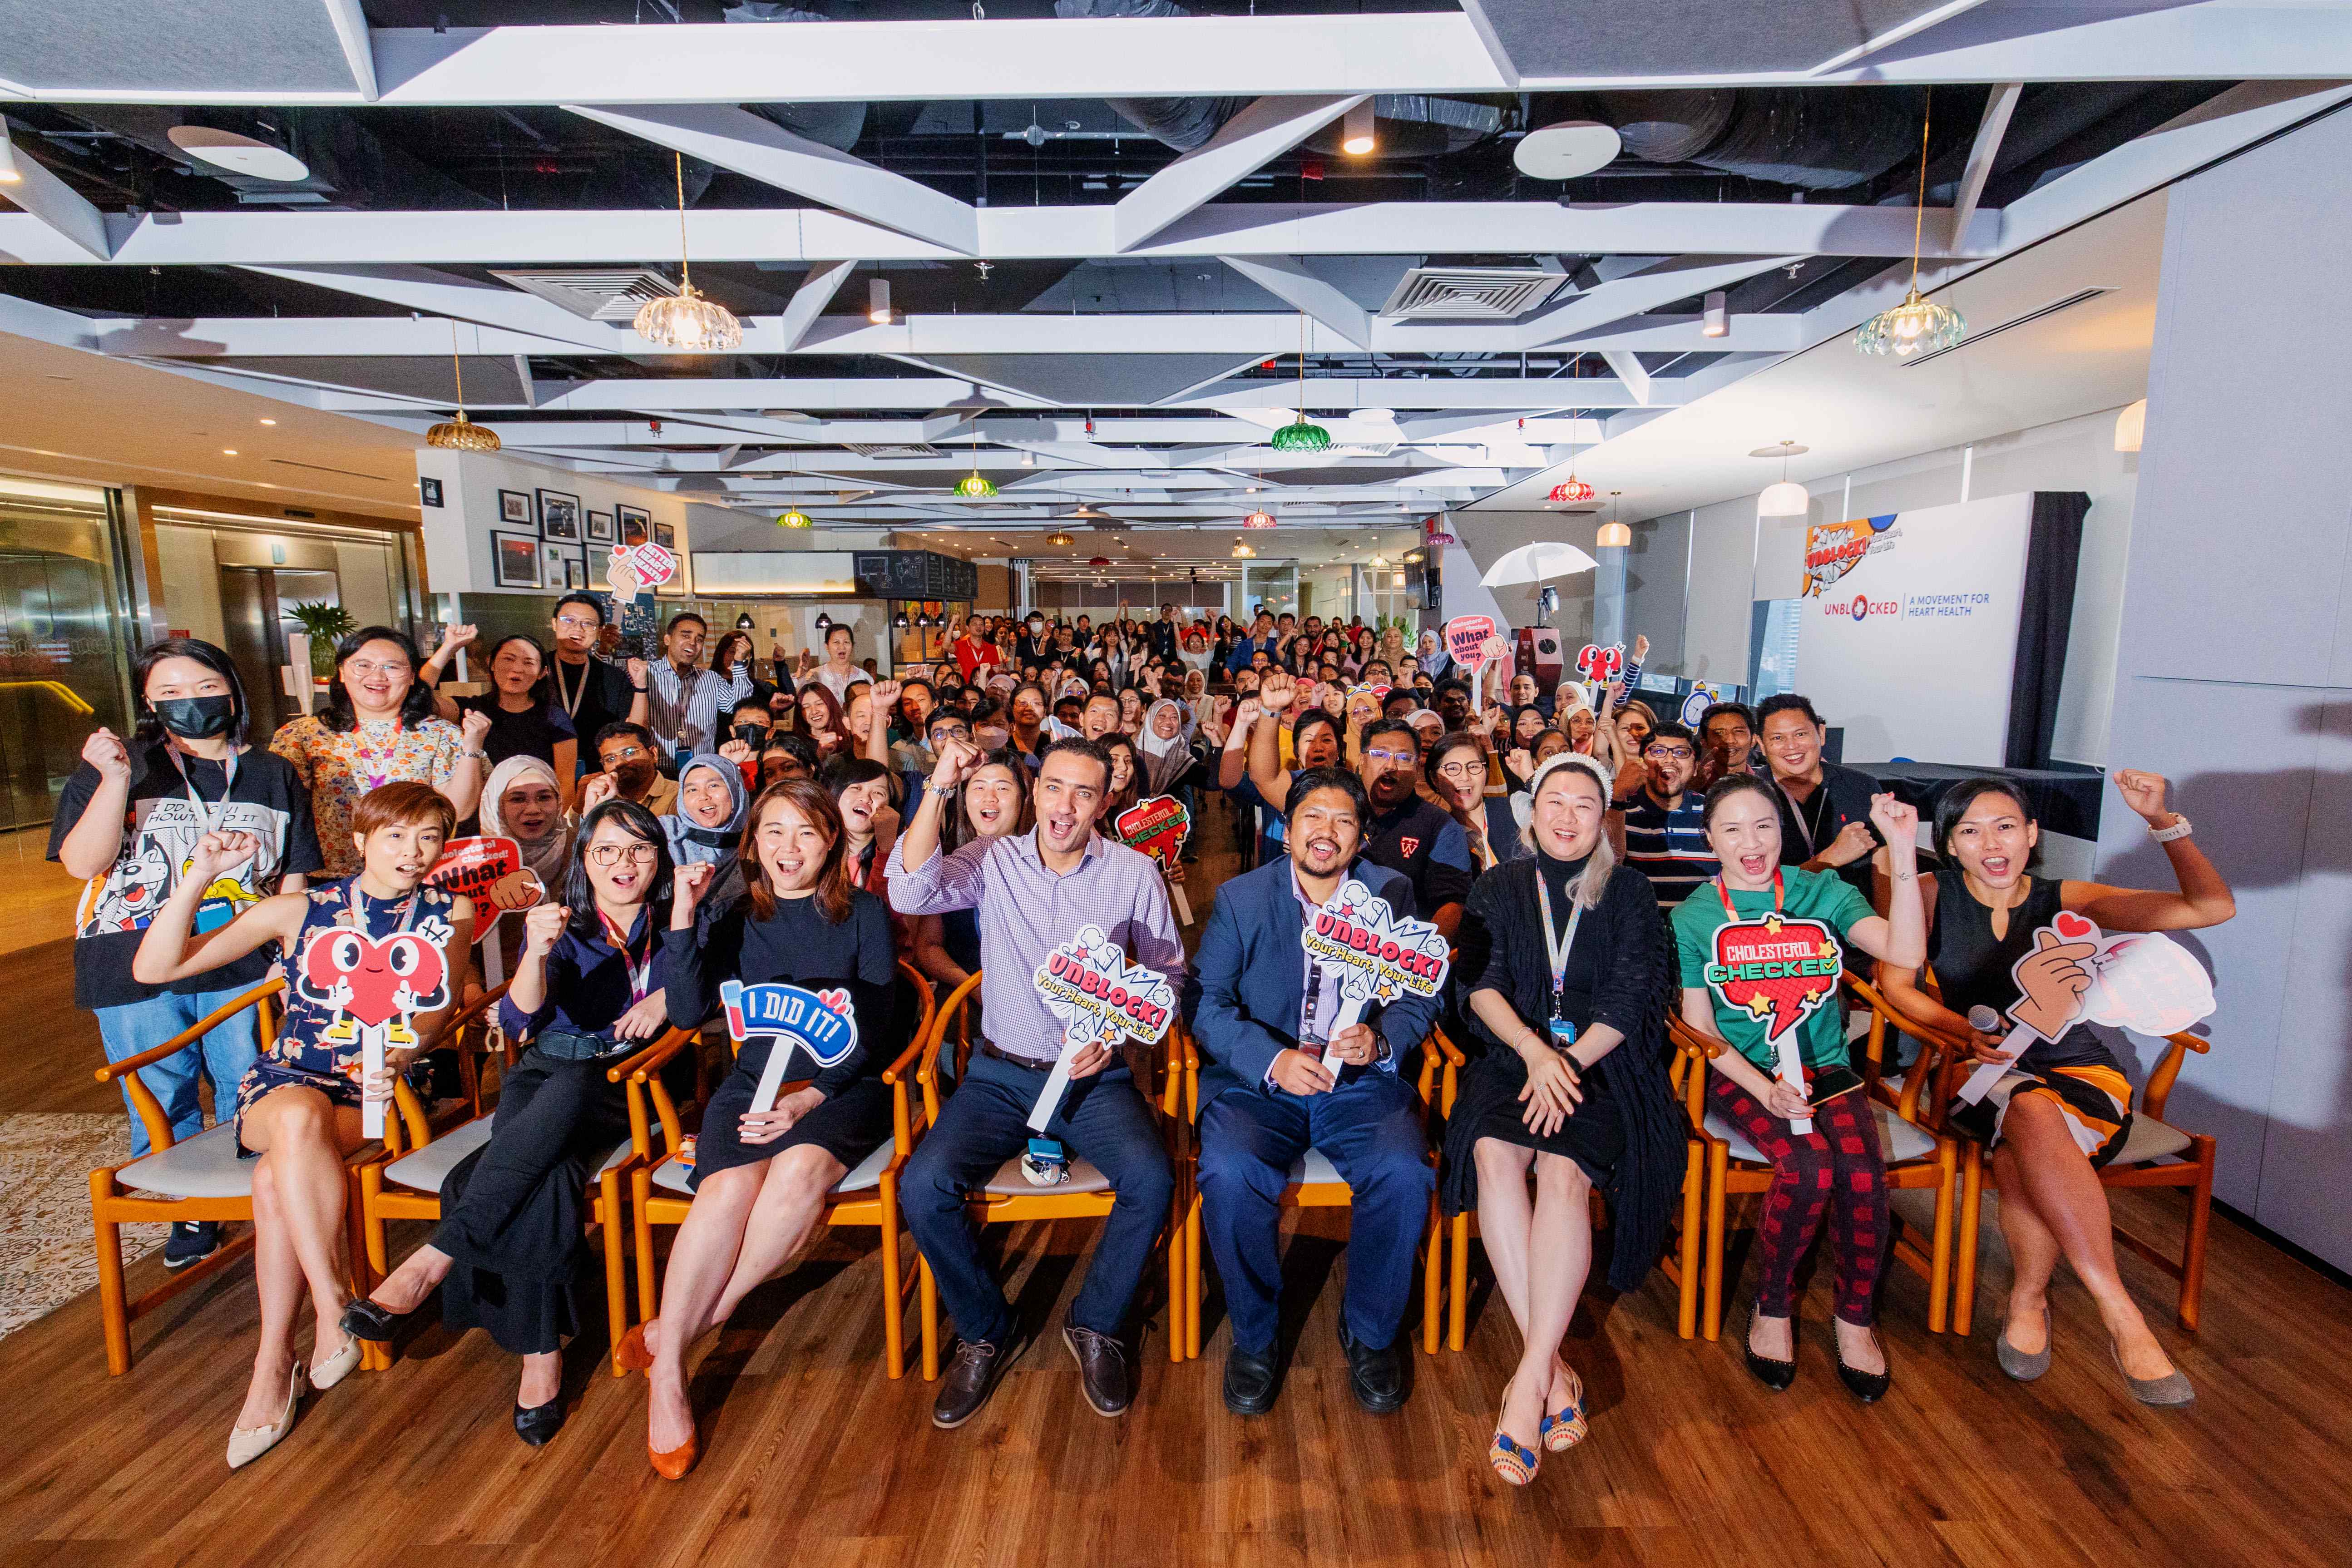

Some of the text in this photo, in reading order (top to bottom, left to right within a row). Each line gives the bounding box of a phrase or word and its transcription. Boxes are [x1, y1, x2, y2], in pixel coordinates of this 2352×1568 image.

[644, 544, 674, 569] BETTER
[1883, 540, 1896, 551] Life
[632, 556, 663, 582] HEALTH
[637, 549, 666, 573] HEART
[1909, 593, 1990, 605] A MOVEMENT FOR
[1908, 606, 1972, 617] HEART HEALTH
[1451, 629, 1488, 646] What
[1454, 643, 1479, 653] about
[1460, 653, 1481, 661] you?
[1124, 808, 1173, 836] CHOLESTEROL
[437, 840, 496, 861] holesterol
[462, 850, 509, 863] checked!
[432, 859, 507, 889] What
[1726, 941, 1816, 962] CHOLESTEROL
[1306, 935, 1434, 994] Your Heart, Your Life
[1708, 958, 1838, 983] CHECKED
[749, 991, 842, 1042] I DID IT!
[1038, 973, 1156, 1042] Your Heart, Your Life
